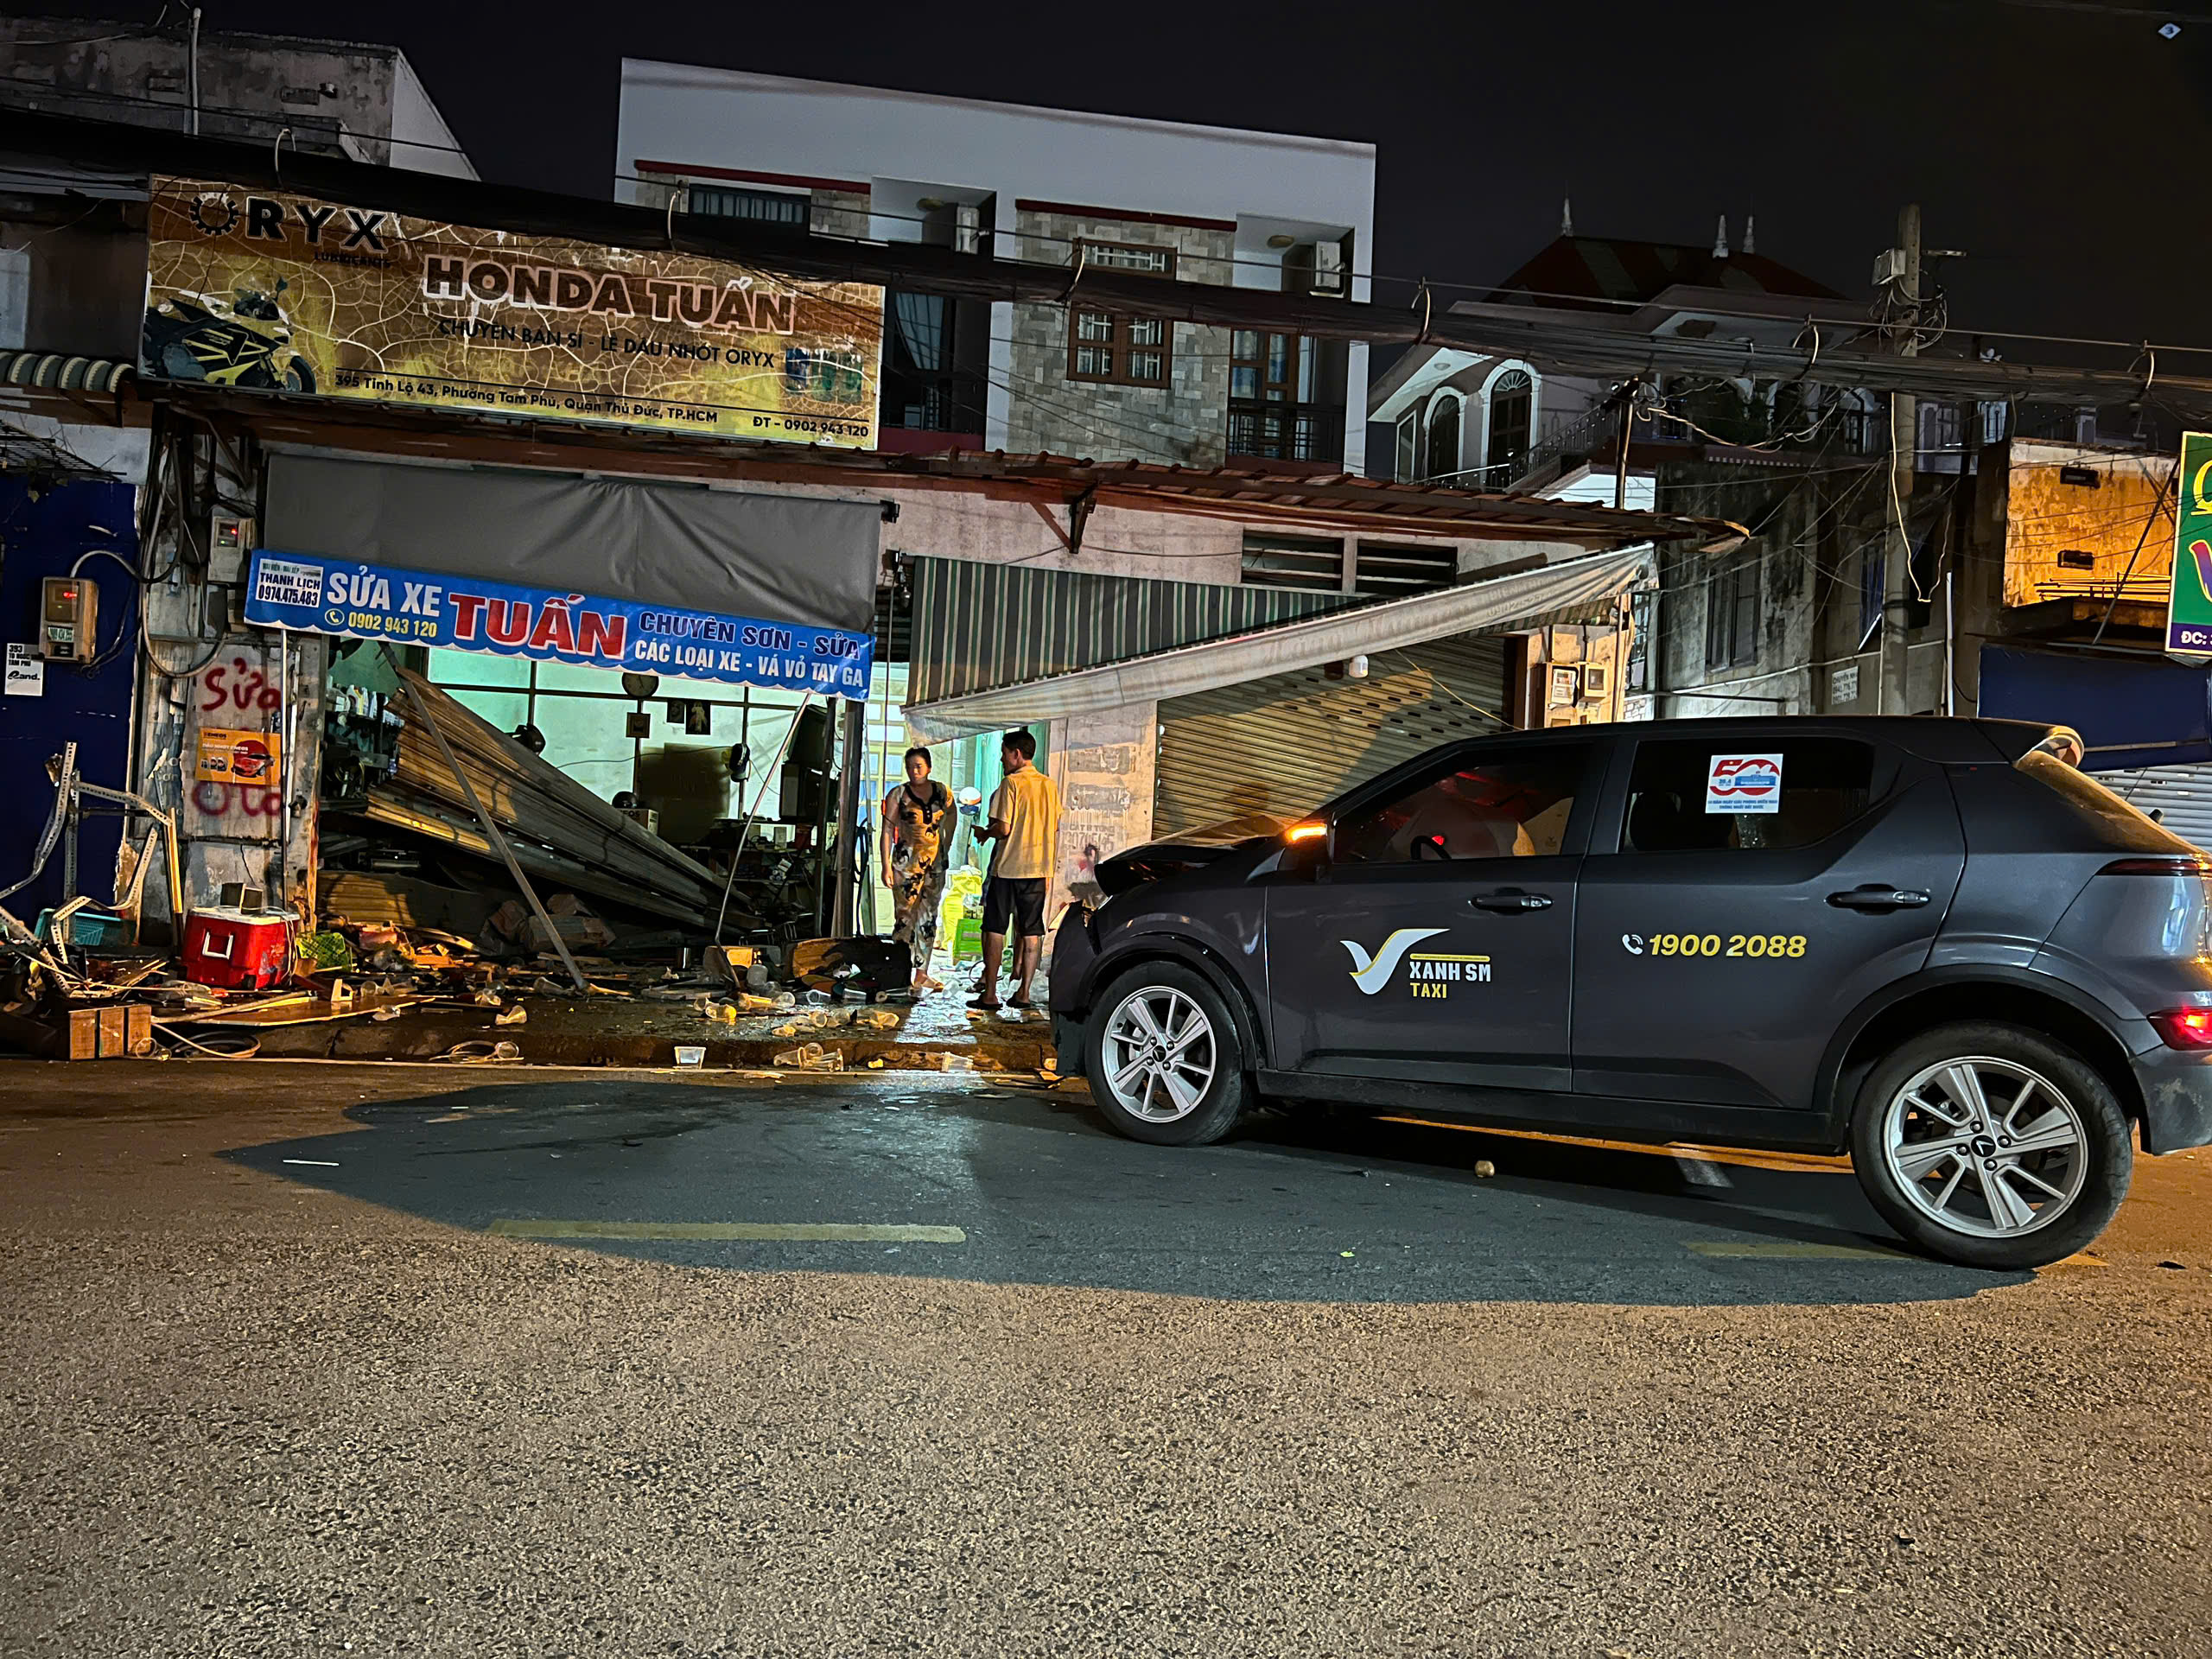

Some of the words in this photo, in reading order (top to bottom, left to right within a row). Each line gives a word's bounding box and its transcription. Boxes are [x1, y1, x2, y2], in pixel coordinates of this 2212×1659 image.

[423, 254, 634, 319] HONDA
[646, 276, 797, 335] TUẤN
[726, 348, 775, 368] ORYX
[397, 380, 414, 396] Lộ
[416, 384, 438, 397] 43,
[499, 391, 526, 404] Tam
[531, 394, 560, 410] Phú,
[564, 397, 601, 413] Quận
[633, 404, 663, 418] Đức,
[667, 407, 718, 423] TP.HCM
[753, 416, 772, 428] ĐT
[785, 420, 817, 432] 0902
[821, 423, 844, 435] 943
[848, 425, 869, 437] 120
[260, 572, 295, 587] THANH
[296, 577, 321, 590] LỊCH
[327, 565, 390, 611] SỬA
[400, 582, 443, 617] XE
[257, 584, 319, 606] 0974.475.483
[348, 612, 381, 632] 0902
[385, 617, 409, 635] 943
[414, 621, 438, 638] 120
[448, 593, 628, 661] TUẤN
[639, 611, 735, 644] CHUYÊN
[741, 625, 791, 651] SƠN
[814, 632, 861, 660] SỬA
[2181, 631, 2208, 645] ĐC:
[635, 639, 671, 663] CÁC
[675, 645, 714, 671] LOẠI
[719, 651, 741, 672] XE
[759, 653, 779, 677] VÁ
[785, 655, 806, 679] VỎ
[812, 662, 839, 684] TAY
[842, 665, 864, 688] GA
[201, 657, 282, 712] Sửa
[1649, 933, 1720, 957] 1900
[1726, 934, 1807, 957] 2088
[1409, 961, 1460, 981] XANH
[1465, 963, 1491, 982] SM
[1409, 982, 1447, 999] TAXI
